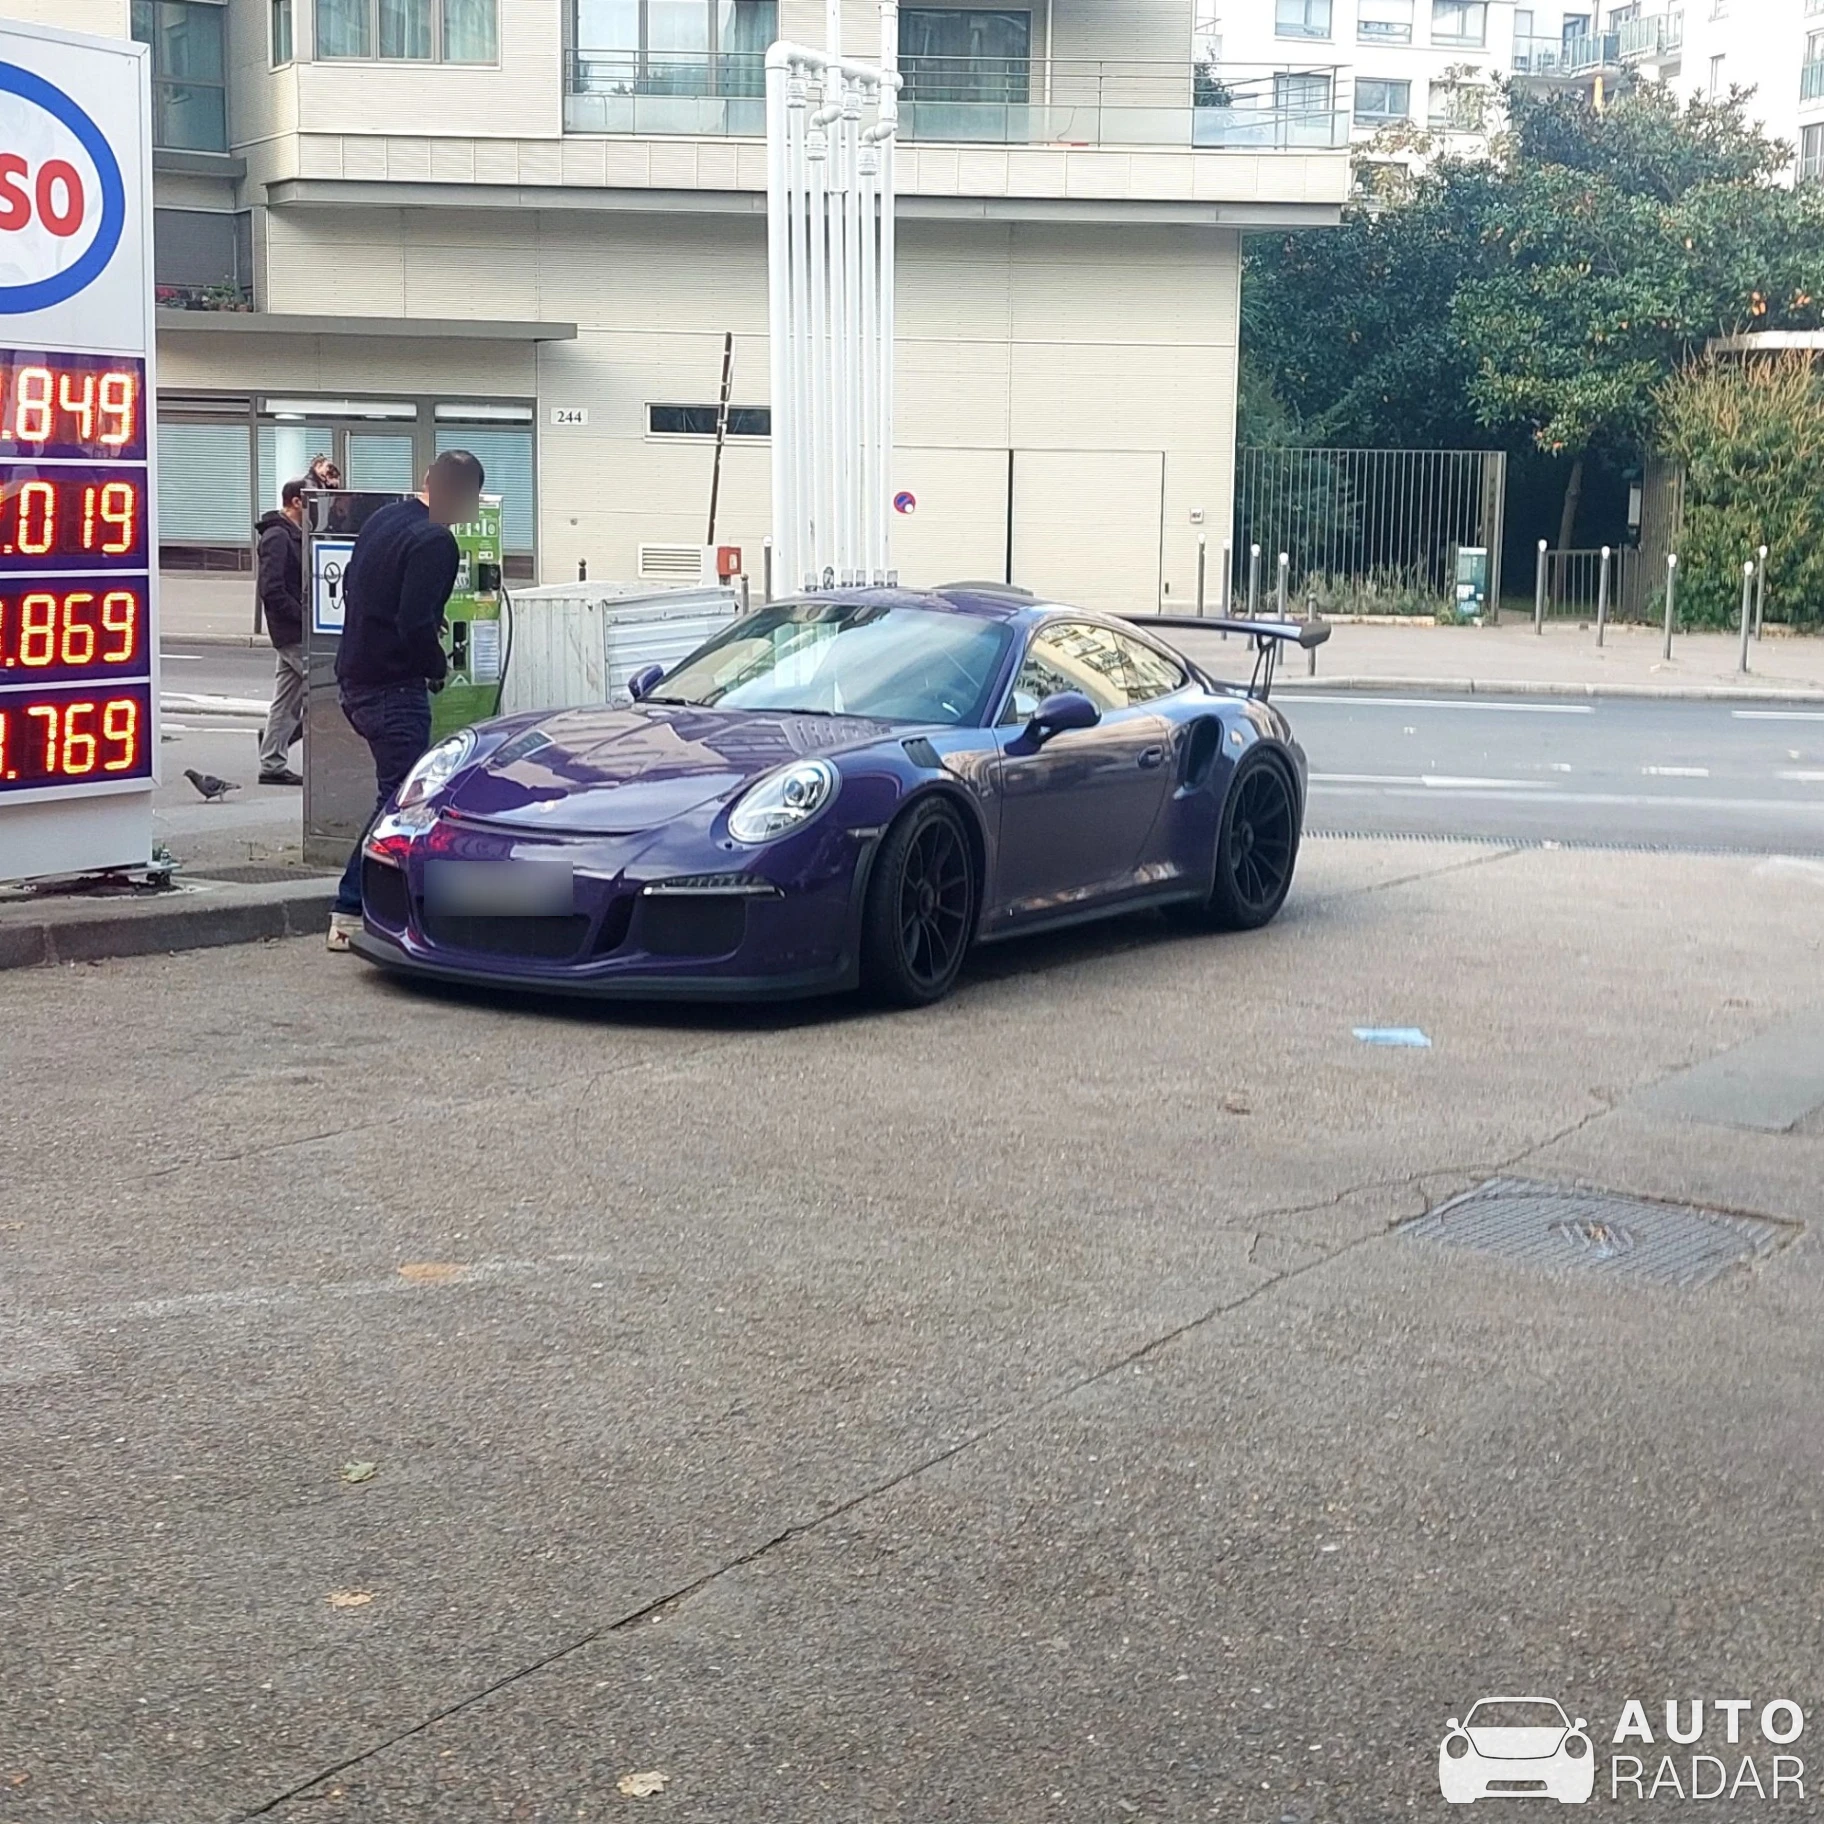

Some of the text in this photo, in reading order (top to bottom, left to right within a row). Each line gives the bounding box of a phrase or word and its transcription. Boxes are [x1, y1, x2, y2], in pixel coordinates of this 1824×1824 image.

[0, 367, 134, 444] .849
[557, 410, 582, 423] 244
[0, 482, 133, 554] .019
[0, 592, 135, 667] .869
[0, 699, 136, 779] .769
